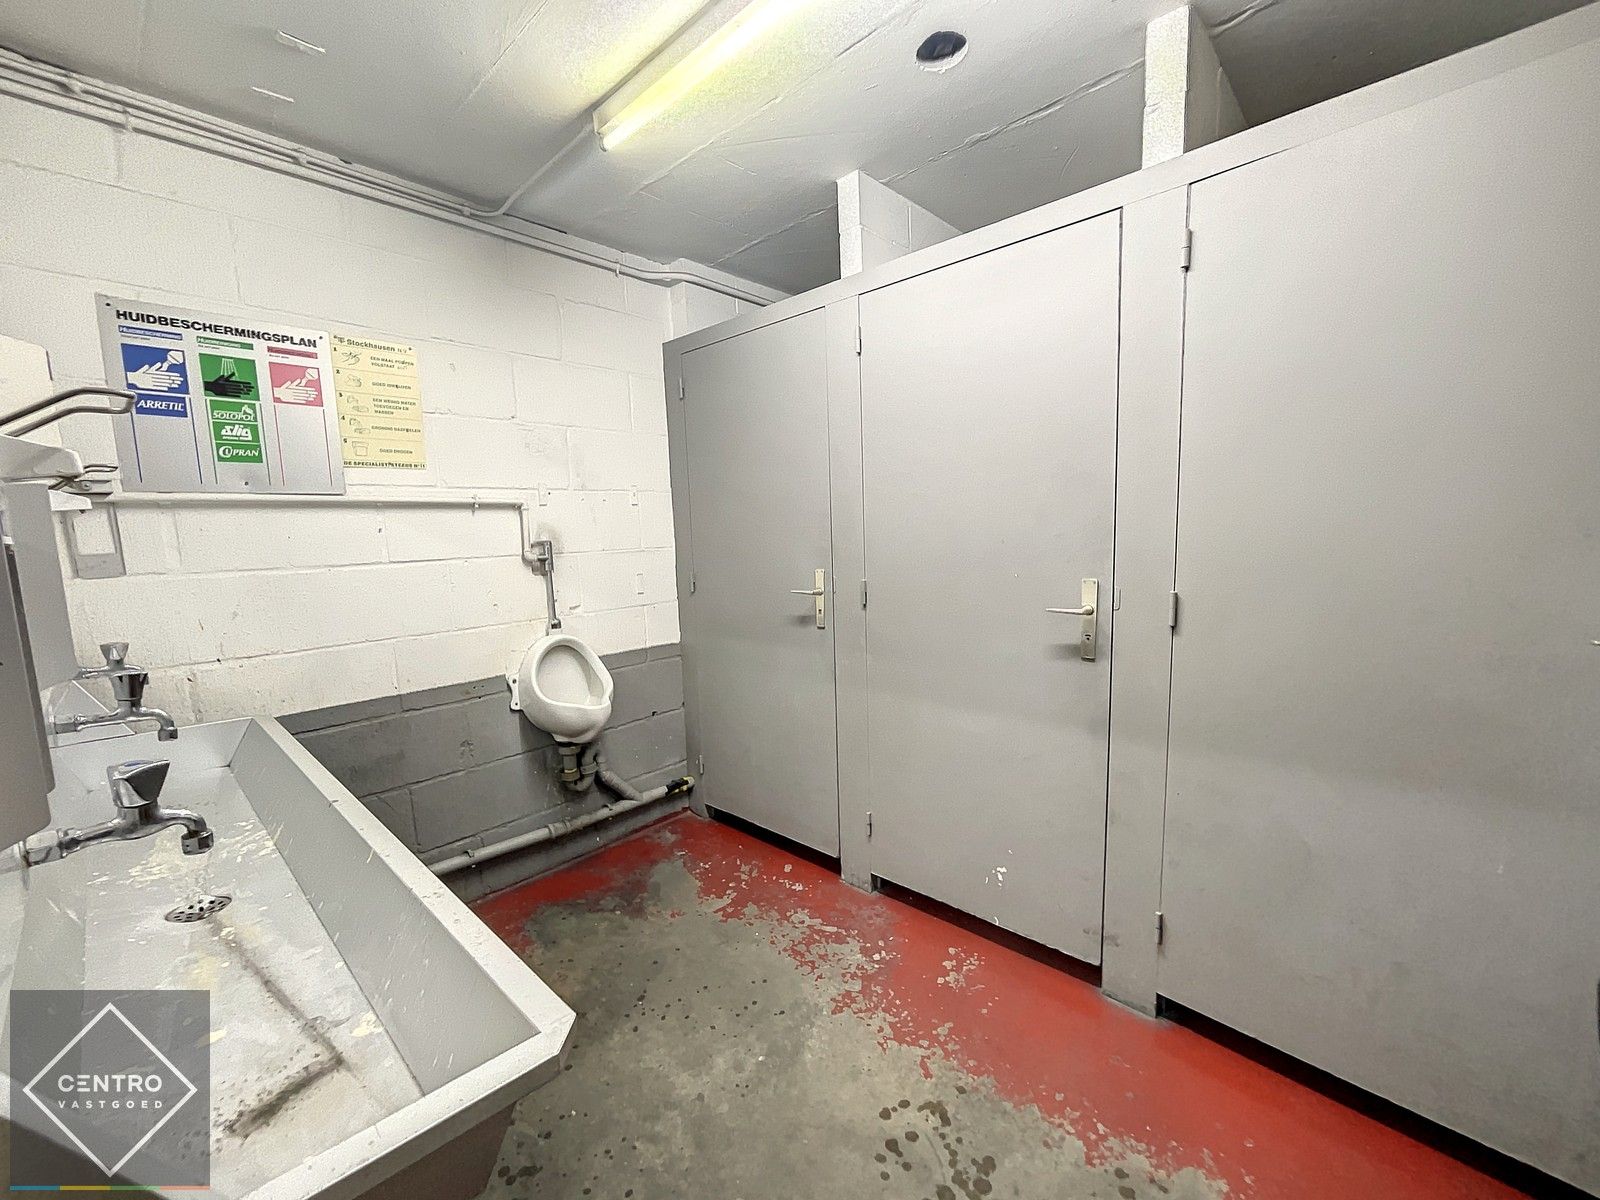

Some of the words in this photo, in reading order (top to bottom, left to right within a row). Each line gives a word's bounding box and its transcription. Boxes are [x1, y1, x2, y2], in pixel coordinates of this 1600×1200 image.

[115, 309, 318, 348] HUIDBESCHERMINGSPLAN
[346, 338, 396, 352] Stockhausen
[136, 399, 185, 412] ARRETIL
[212, 410, 256, 421] SOLOPOL
